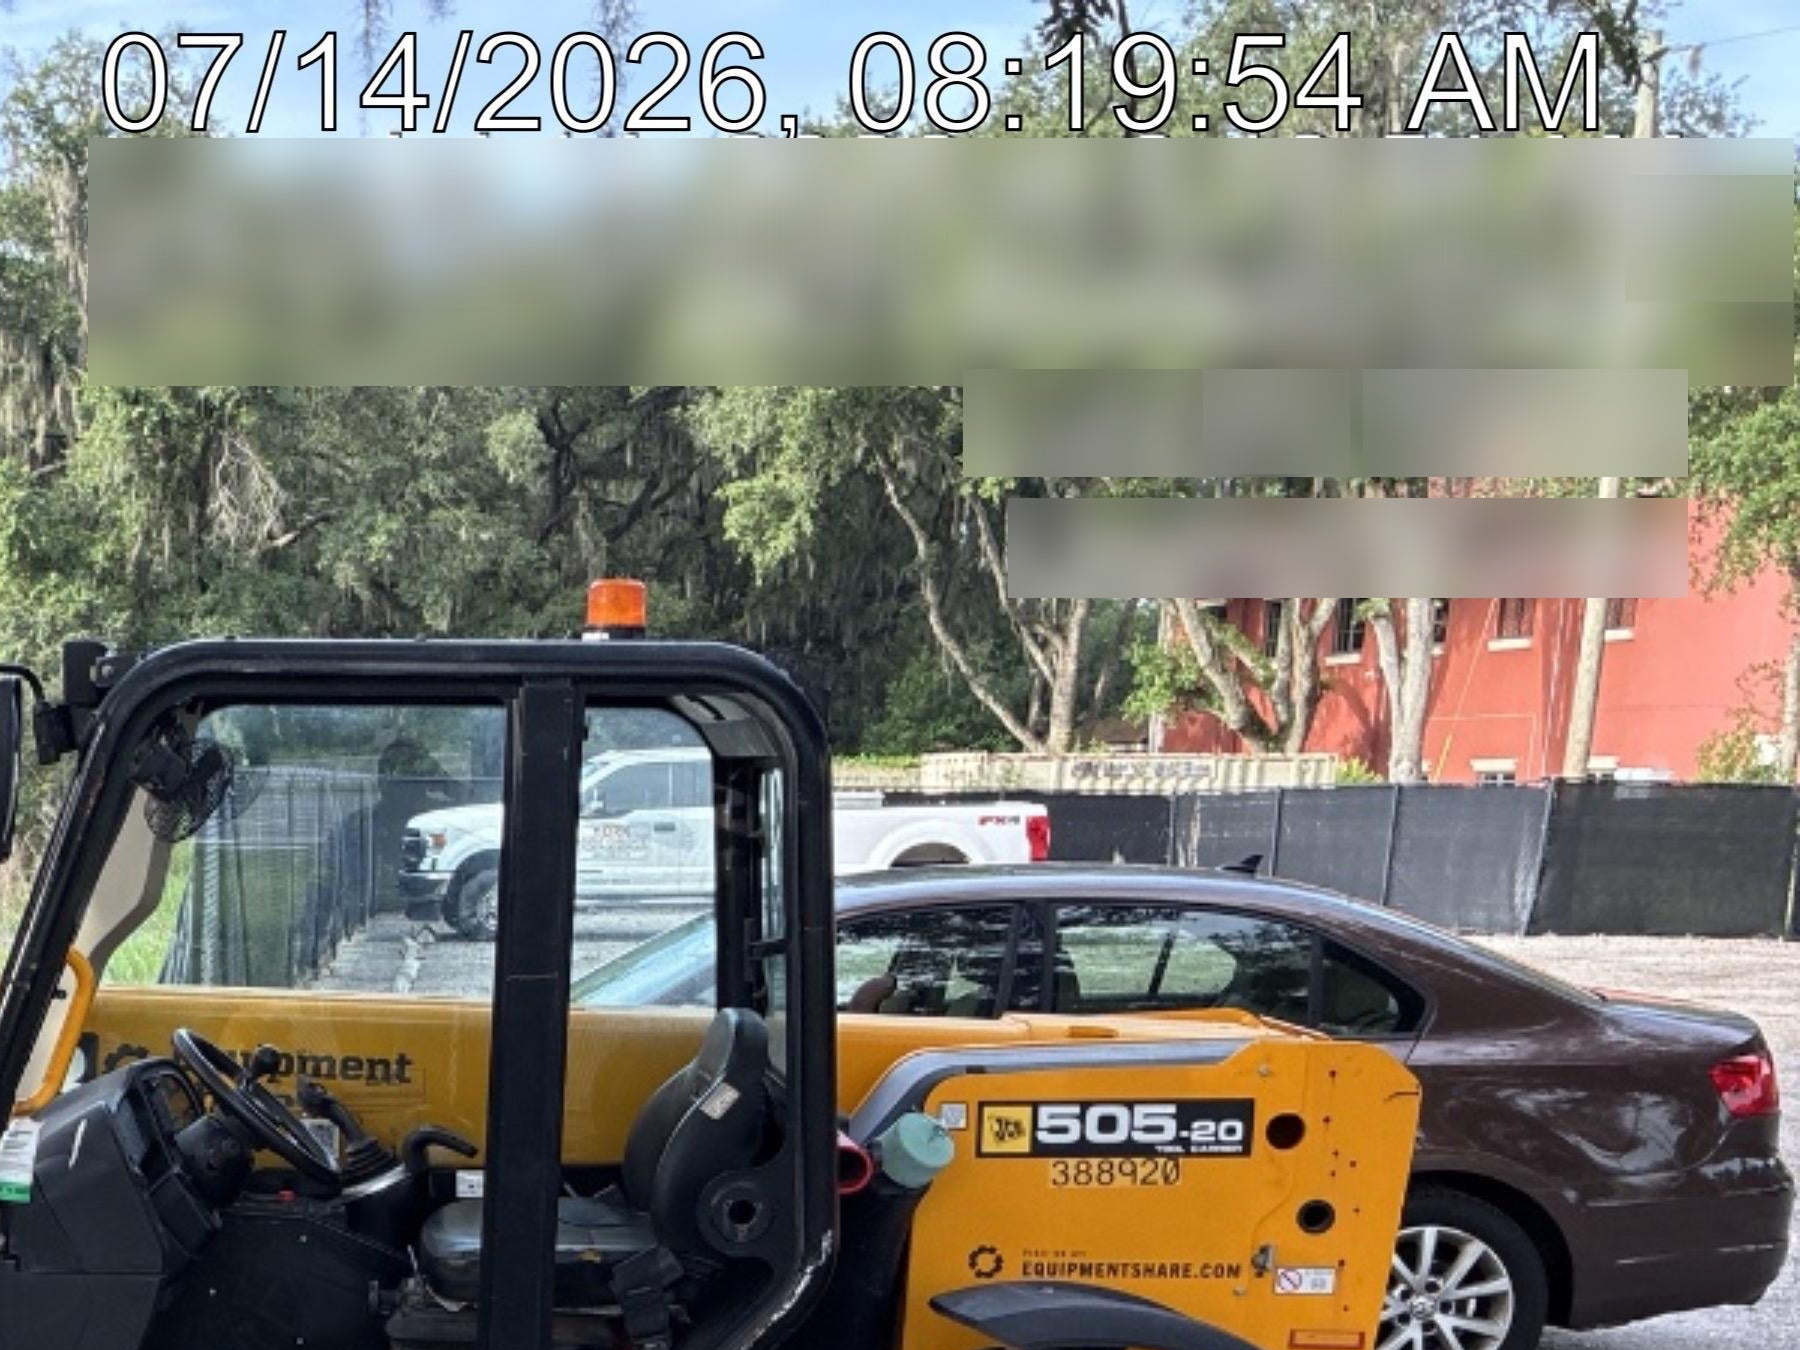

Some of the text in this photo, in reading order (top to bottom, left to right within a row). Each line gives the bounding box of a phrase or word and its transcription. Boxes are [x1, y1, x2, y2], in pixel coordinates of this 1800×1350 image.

[1036, 1103, 1244, 1144] 505-20
[1051, 1160, 1181, 1187] 388920
[1021, 1260, 1241, 1279] EQUIPMENTSHARE.COM
